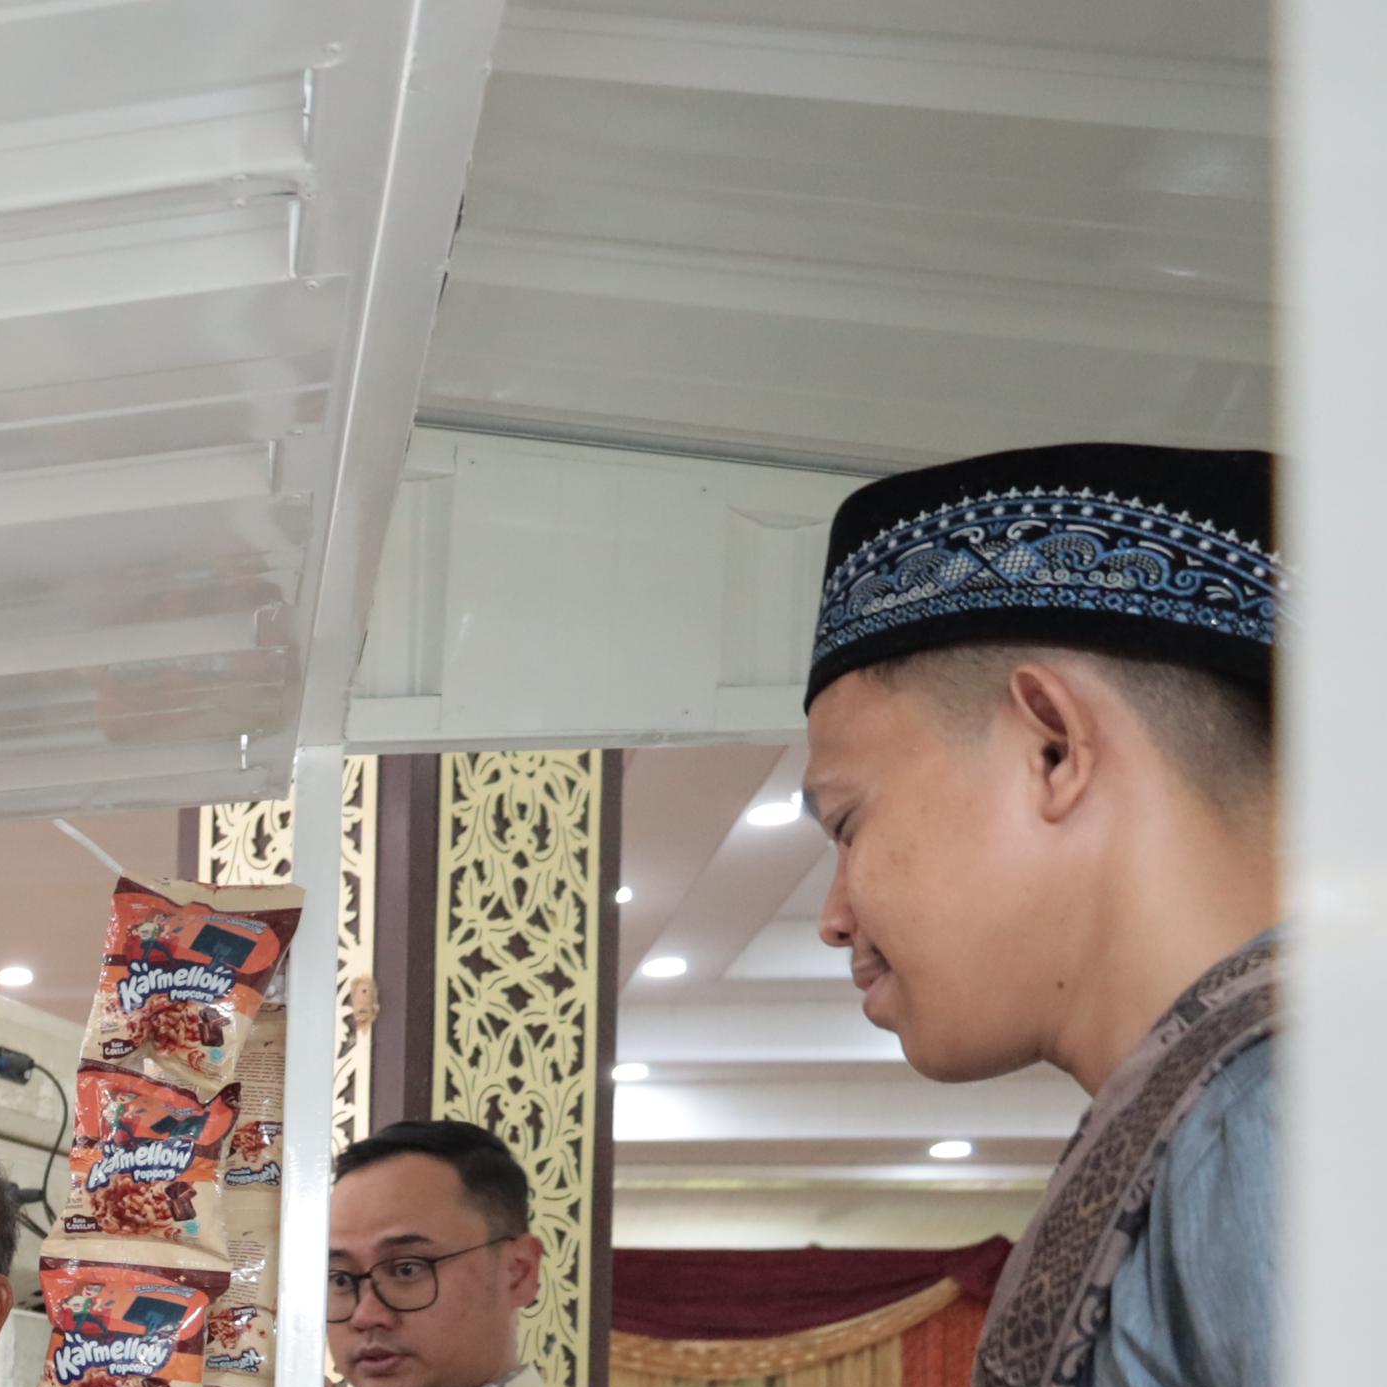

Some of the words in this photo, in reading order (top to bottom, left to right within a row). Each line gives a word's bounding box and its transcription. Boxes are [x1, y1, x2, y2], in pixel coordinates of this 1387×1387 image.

[118, 963, 233, 1014] Karmellow
[170, 989, 215, 1001] Popcorn
[55, 1333, 169, 1380] Karmellow
[108, 1363, 154, 1375] Popcorn
